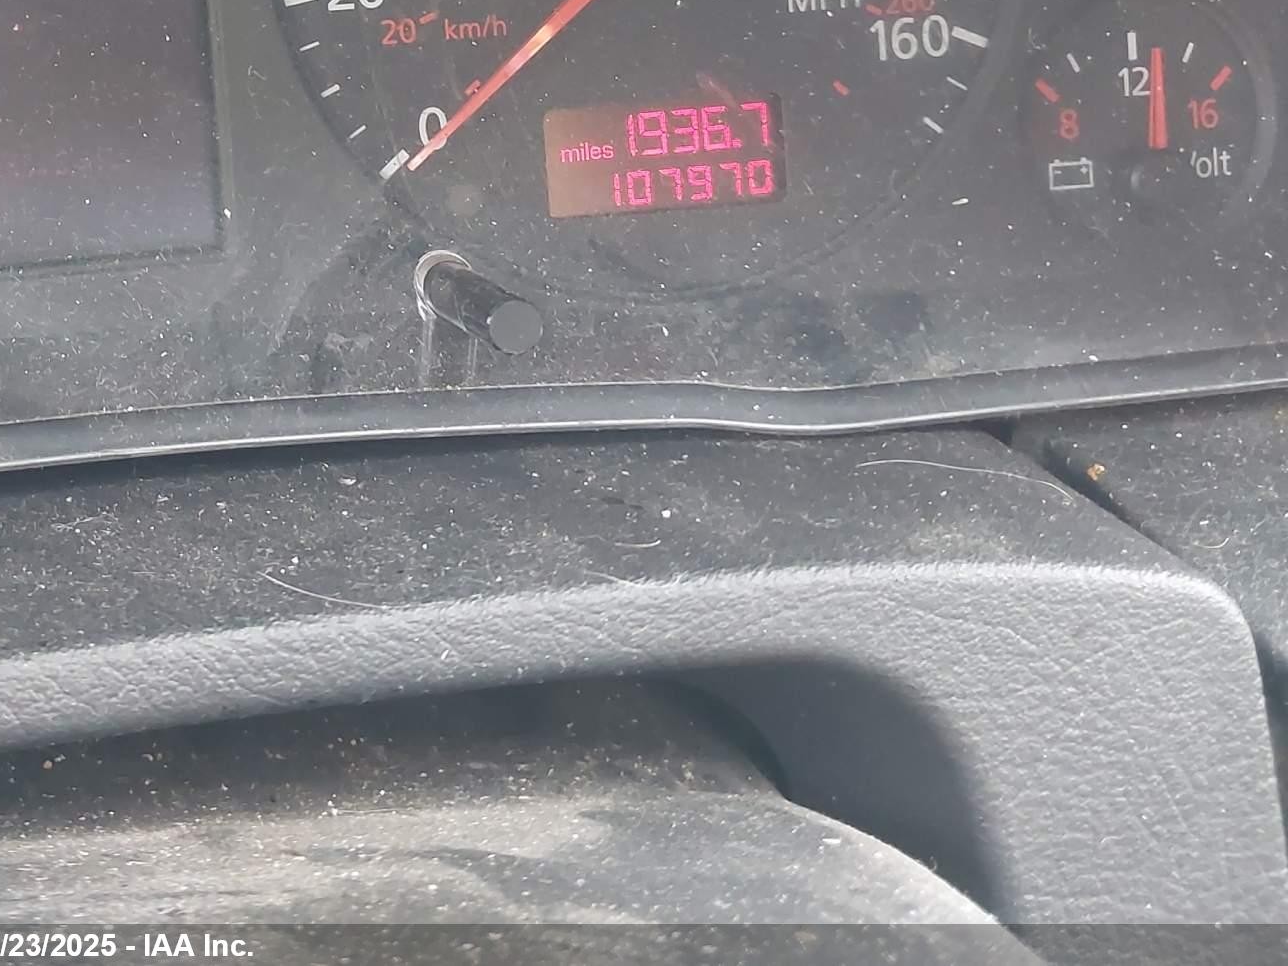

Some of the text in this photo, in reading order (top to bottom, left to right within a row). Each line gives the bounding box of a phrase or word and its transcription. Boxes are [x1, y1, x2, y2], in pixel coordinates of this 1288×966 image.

[381, 18, 417, 46] 20
[444, 14, 507, 40] km/h
[870, 15, 950, 61] 160
[1118, 66, 1150, 97] 12
[418, 107, 447, 150] 0
[1059, 108, 1080, 139] 8
[1188, 98, 1219, 129] 16
[561, 142, 614, 163] miles
[613, 159, 774, 207] 107970
